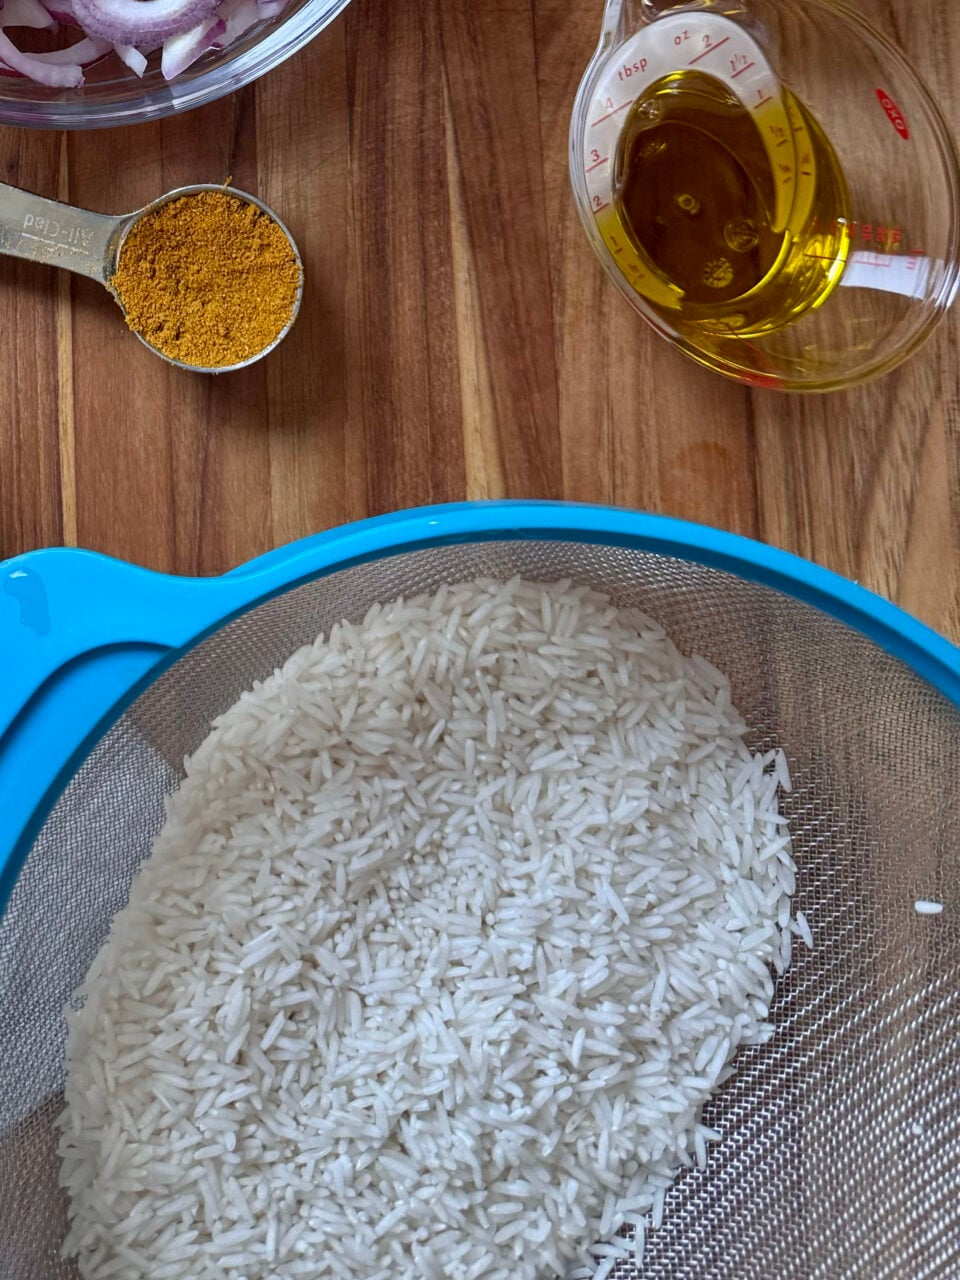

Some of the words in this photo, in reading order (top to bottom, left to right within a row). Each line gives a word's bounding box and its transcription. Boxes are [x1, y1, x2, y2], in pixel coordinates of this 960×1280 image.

[674, 30, 690, 46] oz
[702, 34, 712, 49] 2
[617, 58, 648, 81] tbsp
[605, 96, 614, 110] 4
[881, 98, 906, 130] OXO
[590, 148, 600, 162] 3
[593, 195, 602, 207] 2
[23, 213, 95, 246] All-Clad
